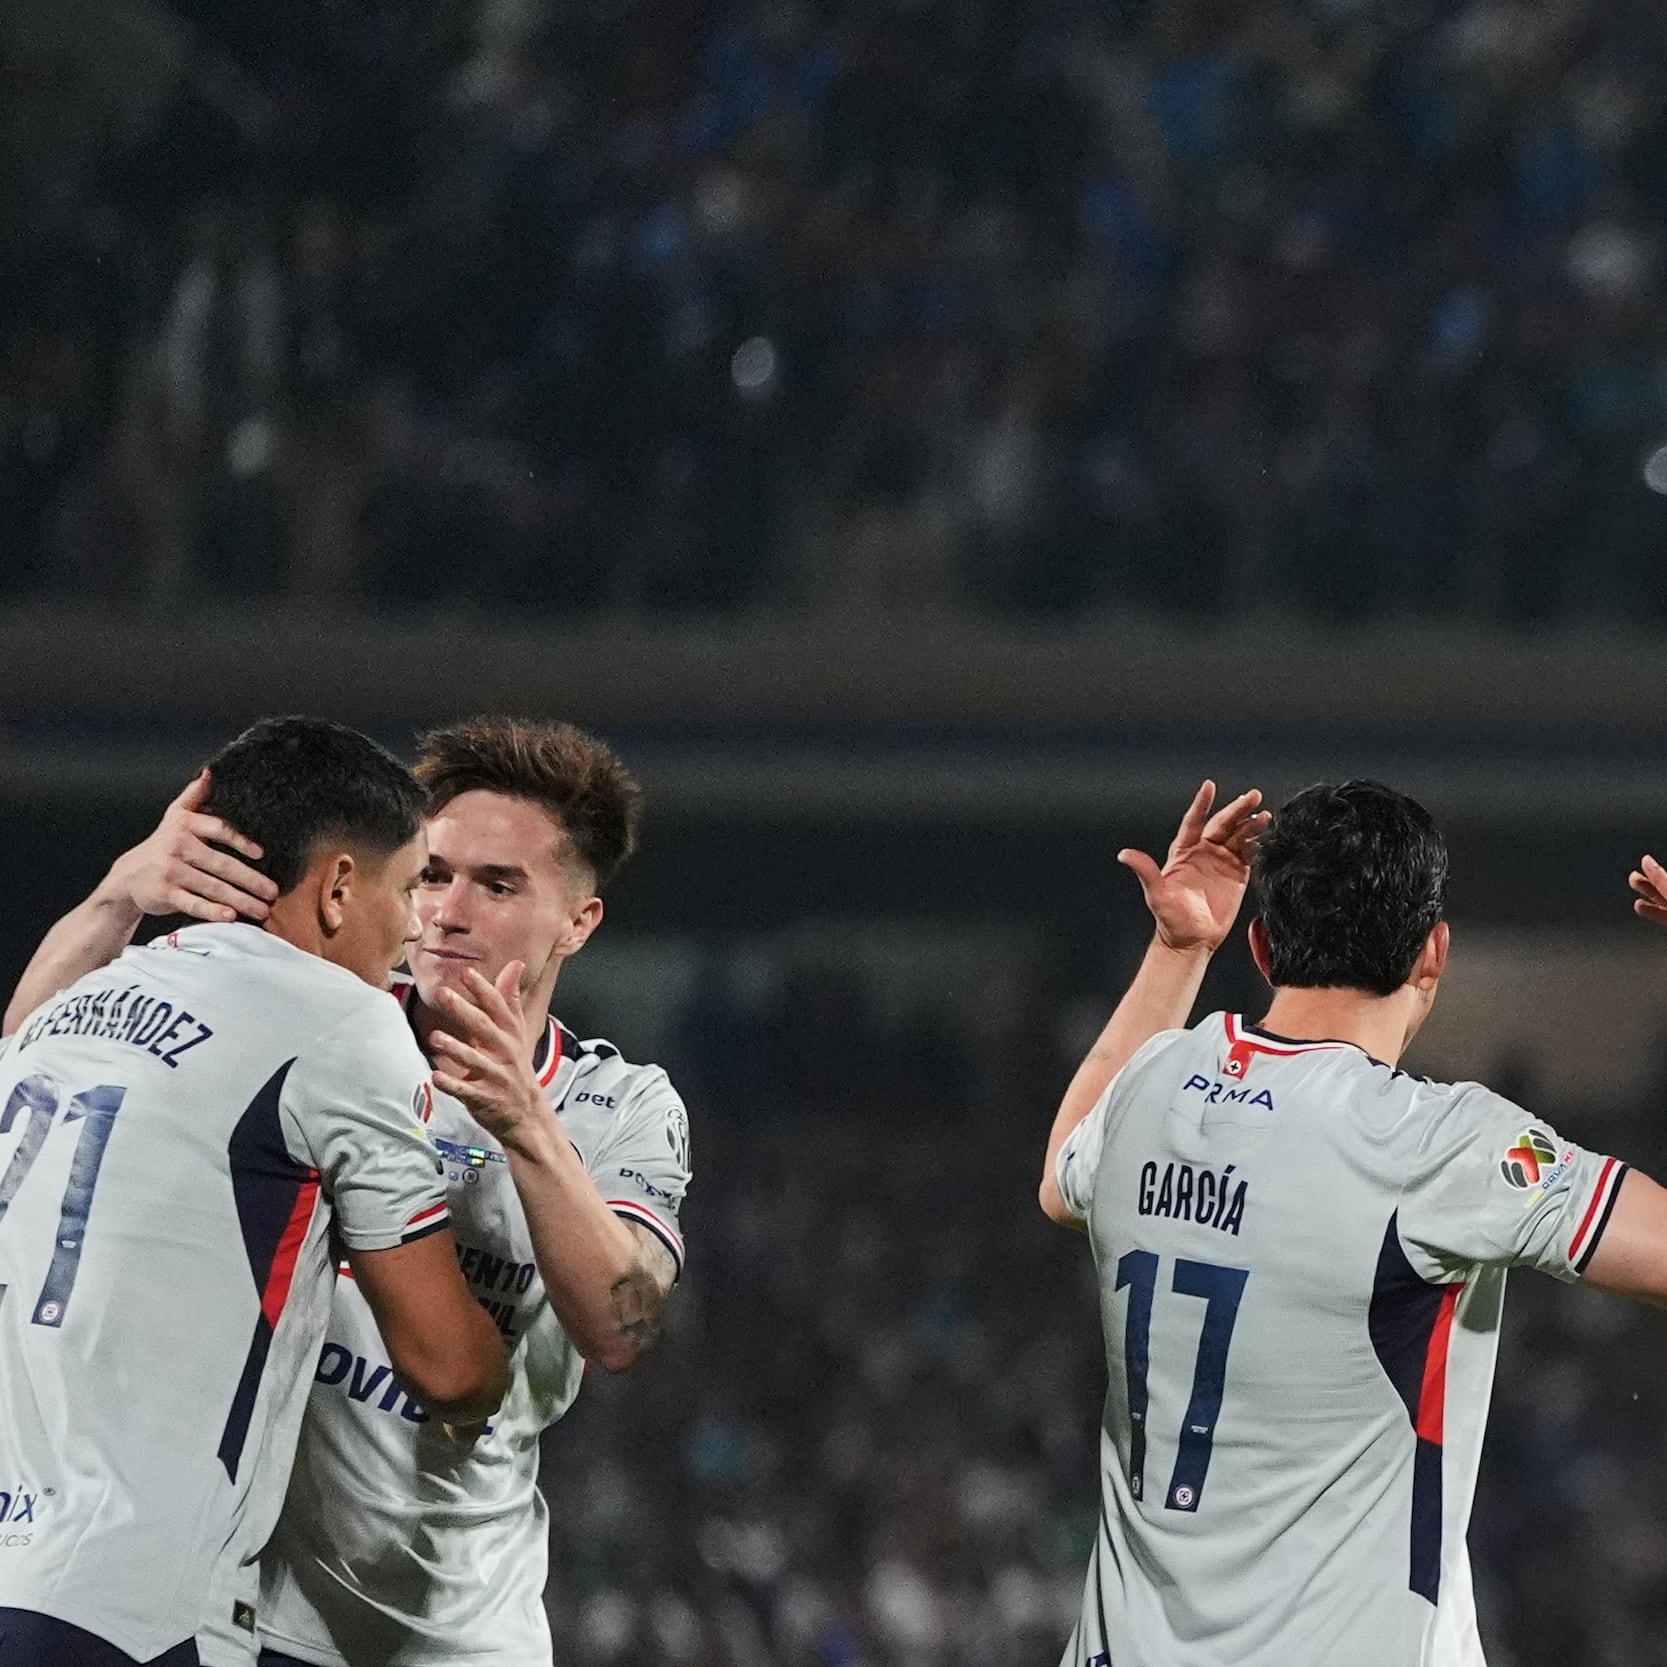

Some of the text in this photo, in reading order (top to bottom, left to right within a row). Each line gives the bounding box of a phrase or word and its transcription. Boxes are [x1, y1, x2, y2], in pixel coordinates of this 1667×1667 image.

[1182, 1073, 1275, 1112] PRMA
[1138, 1160, 1249, 1237] GARCÍA
[1115, 1249, 1250, 1513] 17
